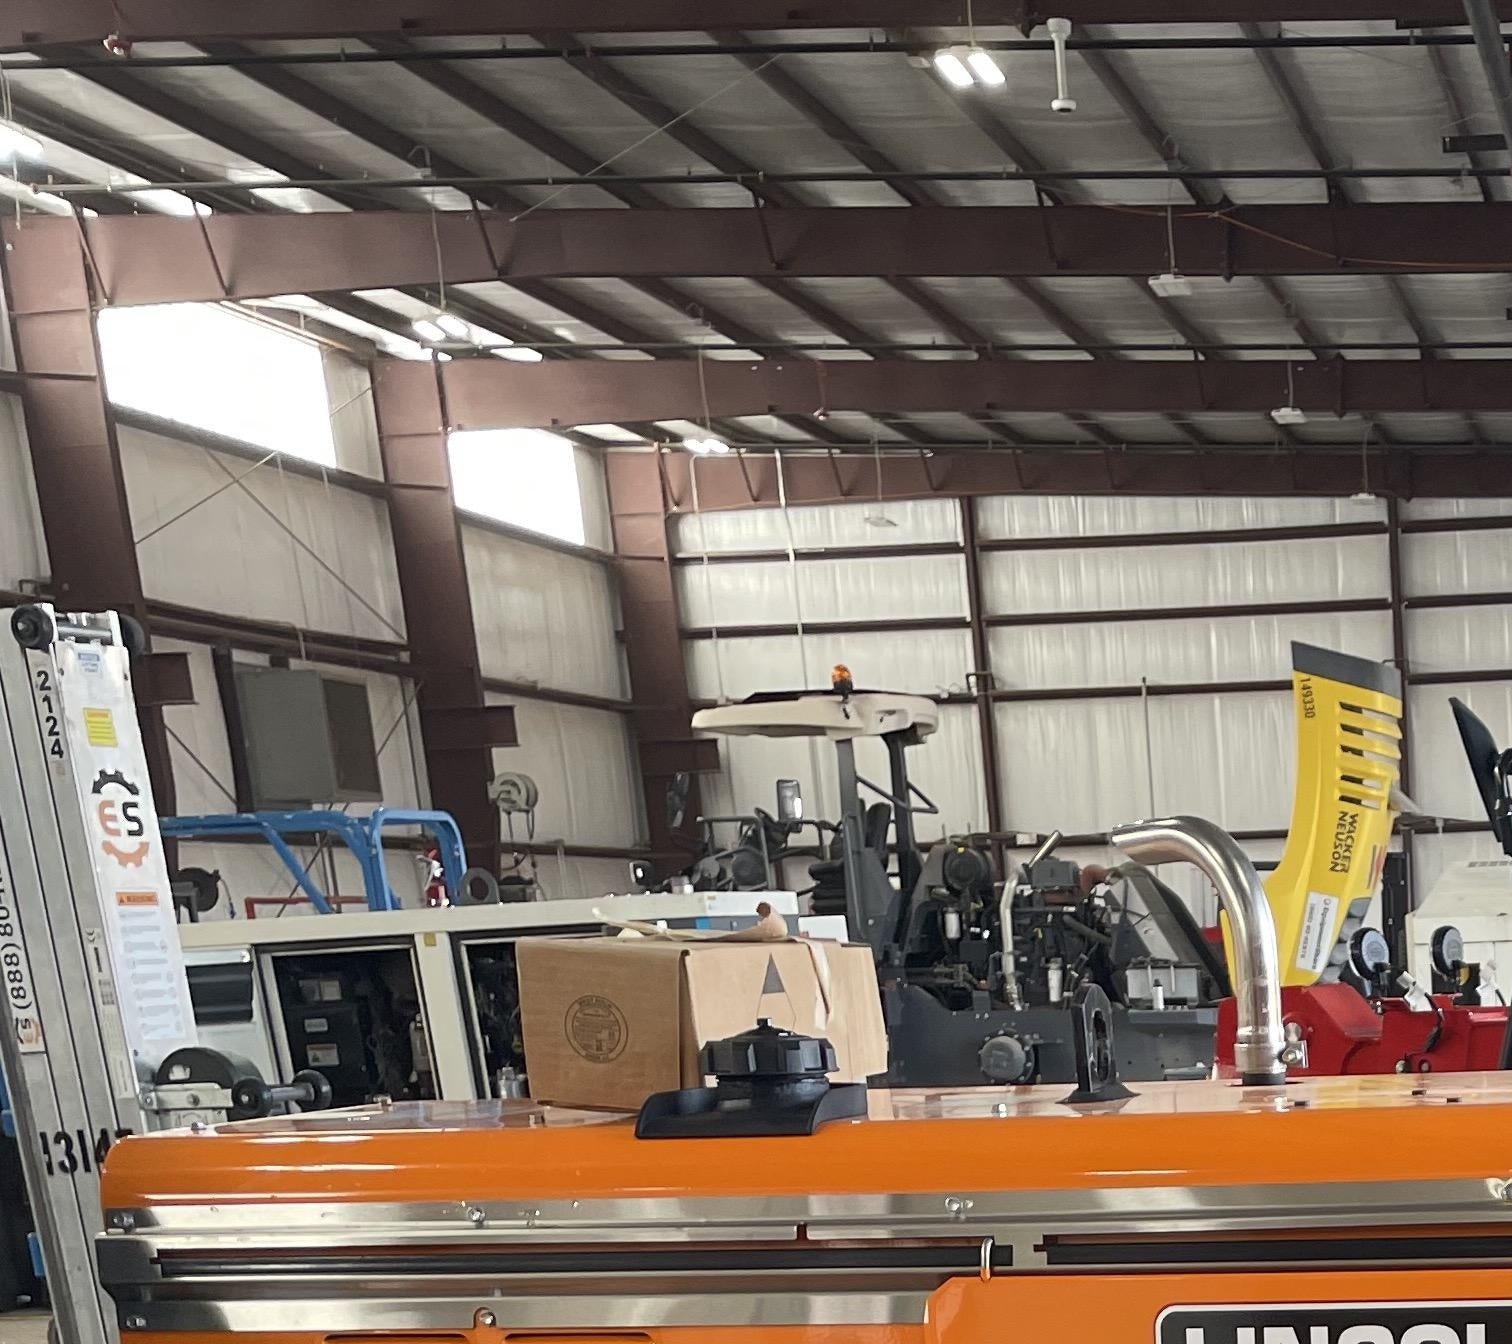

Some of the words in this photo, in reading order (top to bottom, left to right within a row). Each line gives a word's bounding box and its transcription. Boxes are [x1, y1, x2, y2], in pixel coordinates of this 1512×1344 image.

[37, 670, 64, 759] 2124
[1329, 811, 1348, 872] NEUSON
[1340, 812, 1359, 874] WACKER
[2, 942, 32, 1010] (888)
[39, 1127, 134, 1176] 1314
